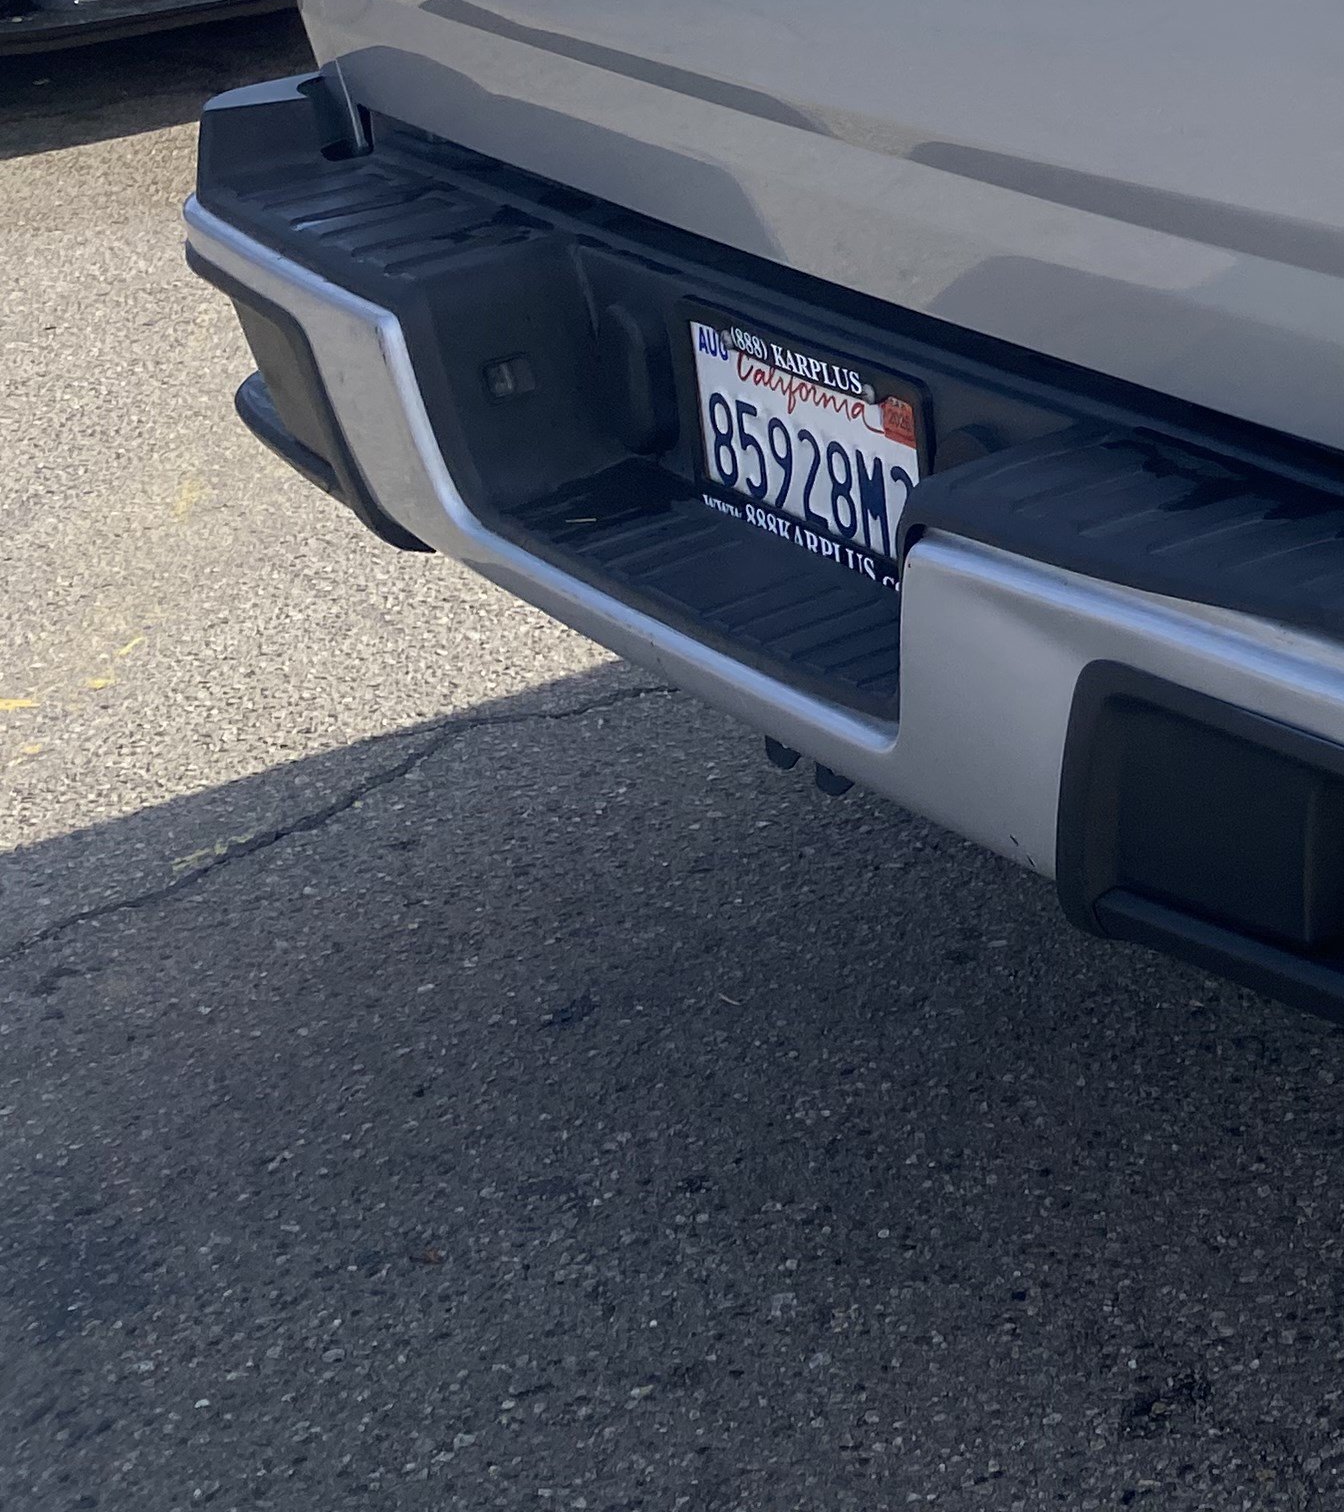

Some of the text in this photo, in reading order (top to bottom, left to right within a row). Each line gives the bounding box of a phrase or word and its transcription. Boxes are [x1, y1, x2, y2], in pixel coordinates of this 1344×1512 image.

[730, 325, 863, 395] (888) KARPLUS
[735, 350, 885, 435] California
